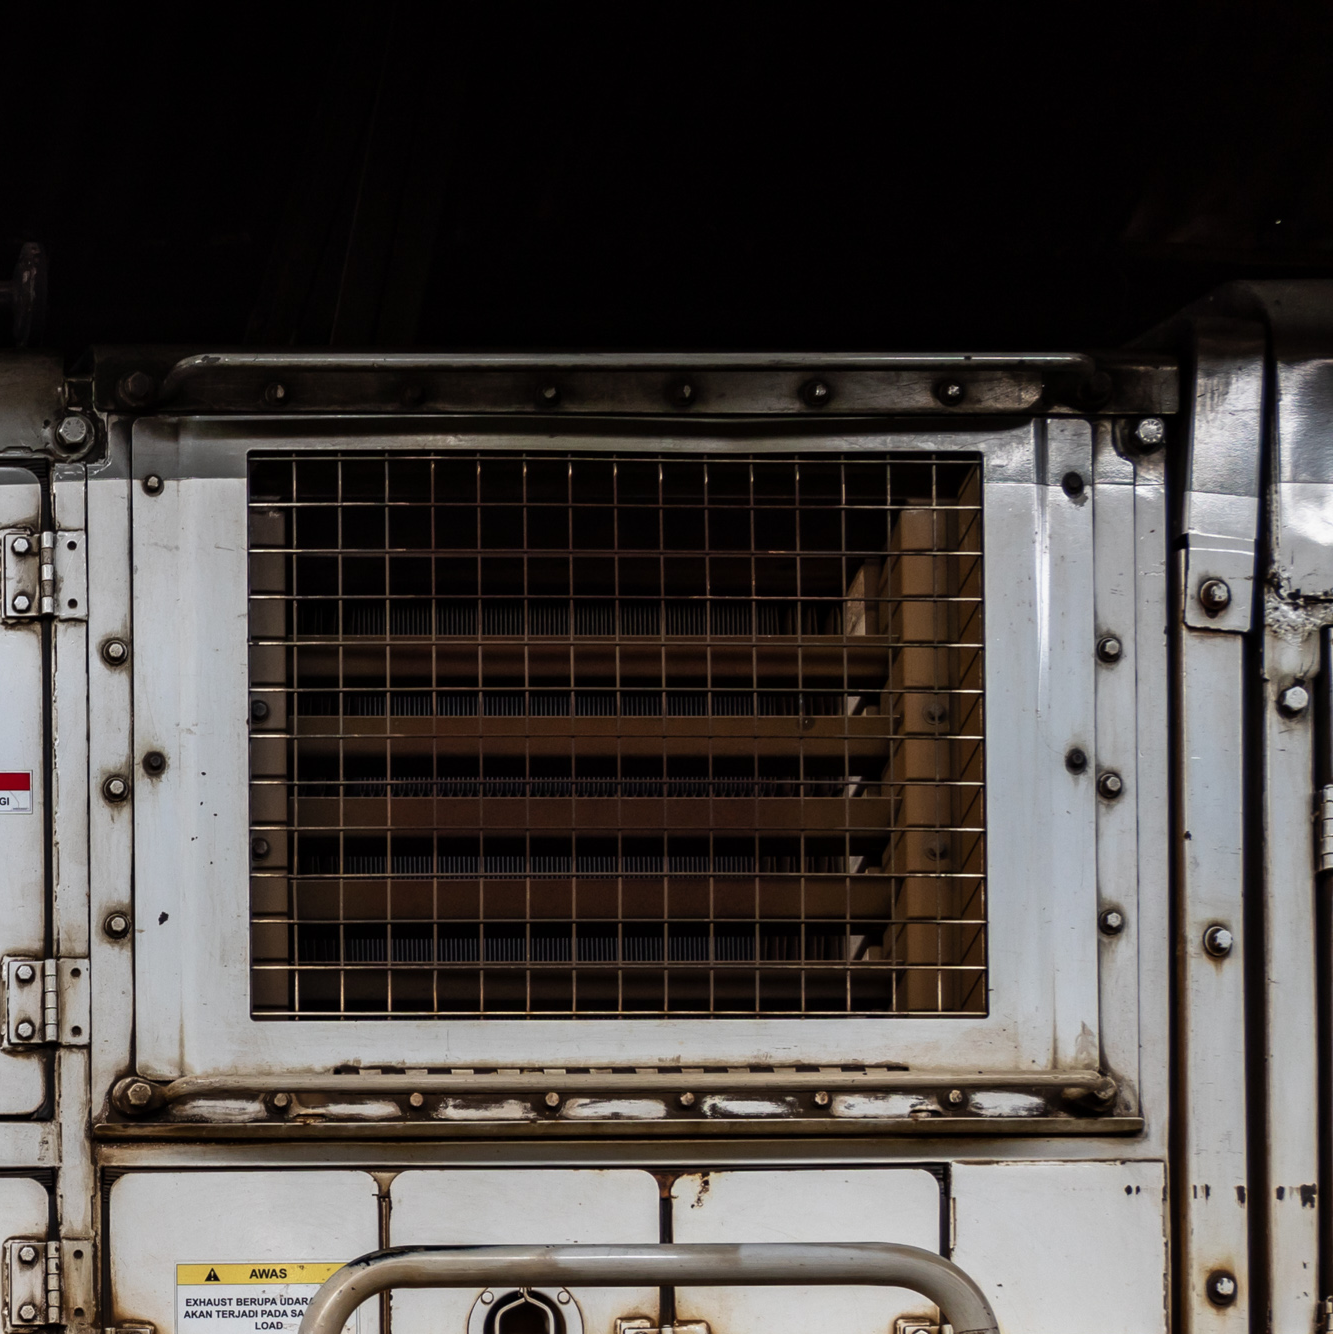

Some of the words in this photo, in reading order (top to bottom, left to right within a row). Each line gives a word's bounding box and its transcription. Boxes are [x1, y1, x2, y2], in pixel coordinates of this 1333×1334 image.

[249, 1268, 288, 1280] AWAS
[185, 1298, 234, 1307] EXHAUST
[236, 1297, 277, 1306] BERUPA
[184, 1310, 213, 1319] AKAN
[216, 1310, 258, 1318] TERJADI
[260, 1309, 288, 1318] PADA
[255, 1321, 283, 1330] LOAD
